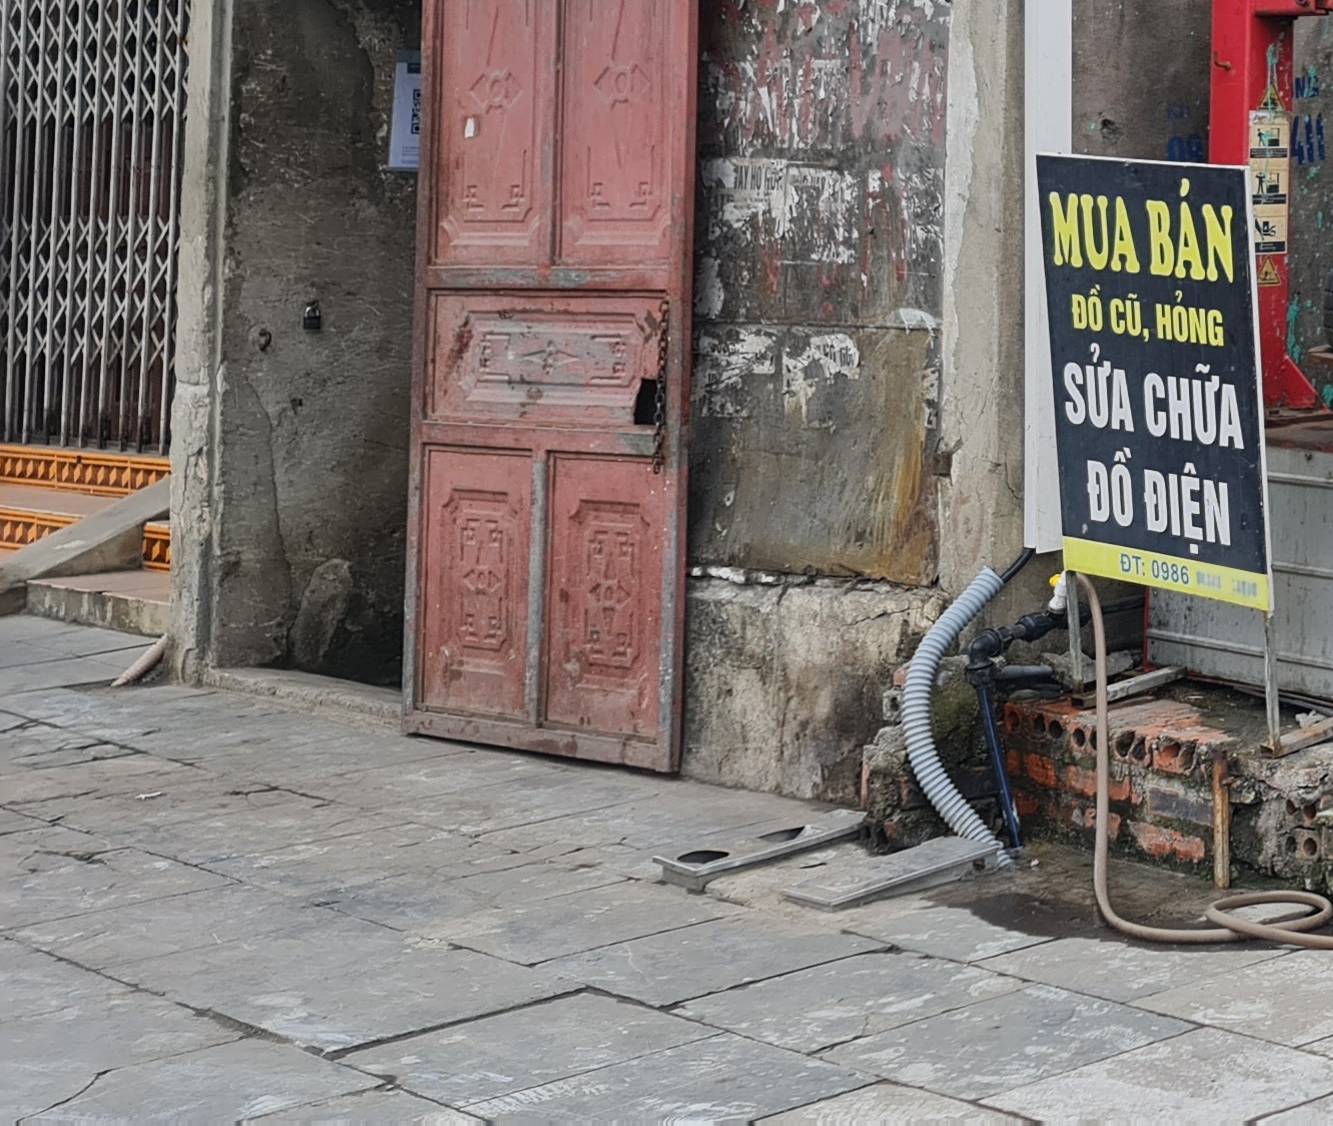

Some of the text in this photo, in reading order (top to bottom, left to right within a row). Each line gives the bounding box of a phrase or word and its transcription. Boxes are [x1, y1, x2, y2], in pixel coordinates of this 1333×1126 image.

[1049, 178, 1234, 284] MUA BÁN
[1071, 284, 1225, 347] ĐỒ CŨ, HỎNG
[1063, 342, 1245, 450] SỬA CHỮA
[1087, 447, 1231, 554] ĐỒ ĐIỆN
[1120, 553, 1145, 576] ĐT:
[1152, 560, 1190, 584] 0986
